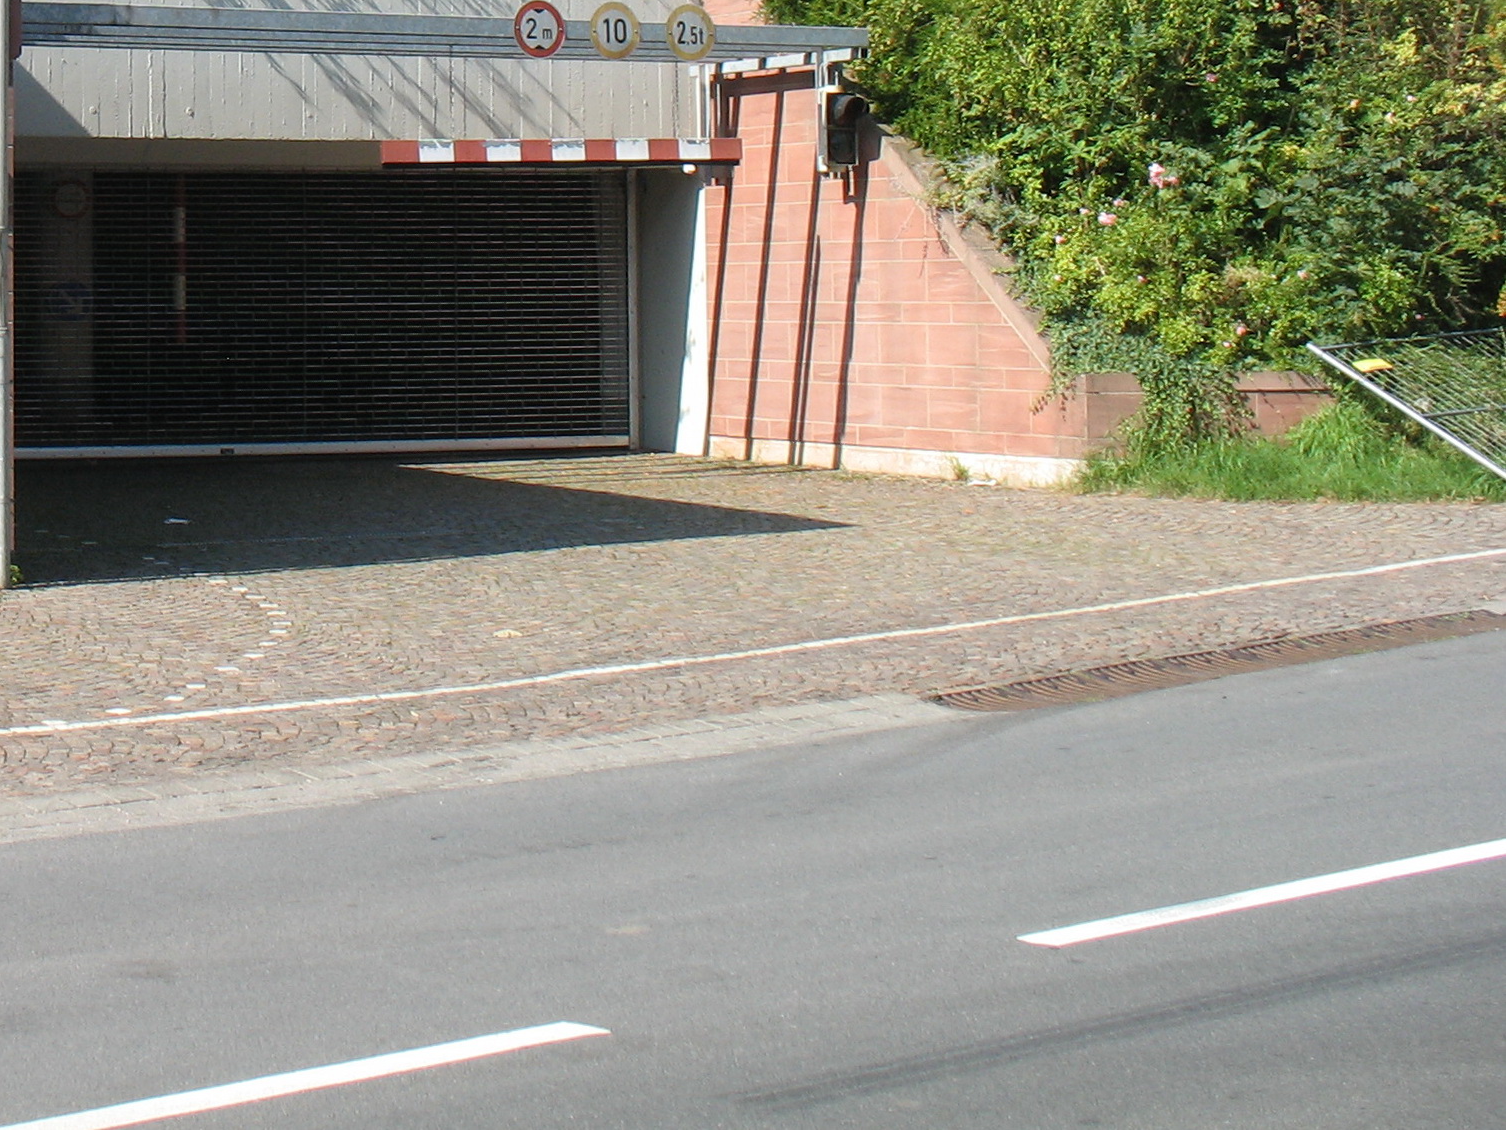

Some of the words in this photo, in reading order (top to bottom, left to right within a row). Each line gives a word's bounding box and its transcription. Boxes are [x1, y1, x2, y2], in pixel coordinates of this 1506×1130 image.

[526, 18, 537, 39] 2
[542, 29, 552, 40] m
[603, 17, 627, 44] 10
